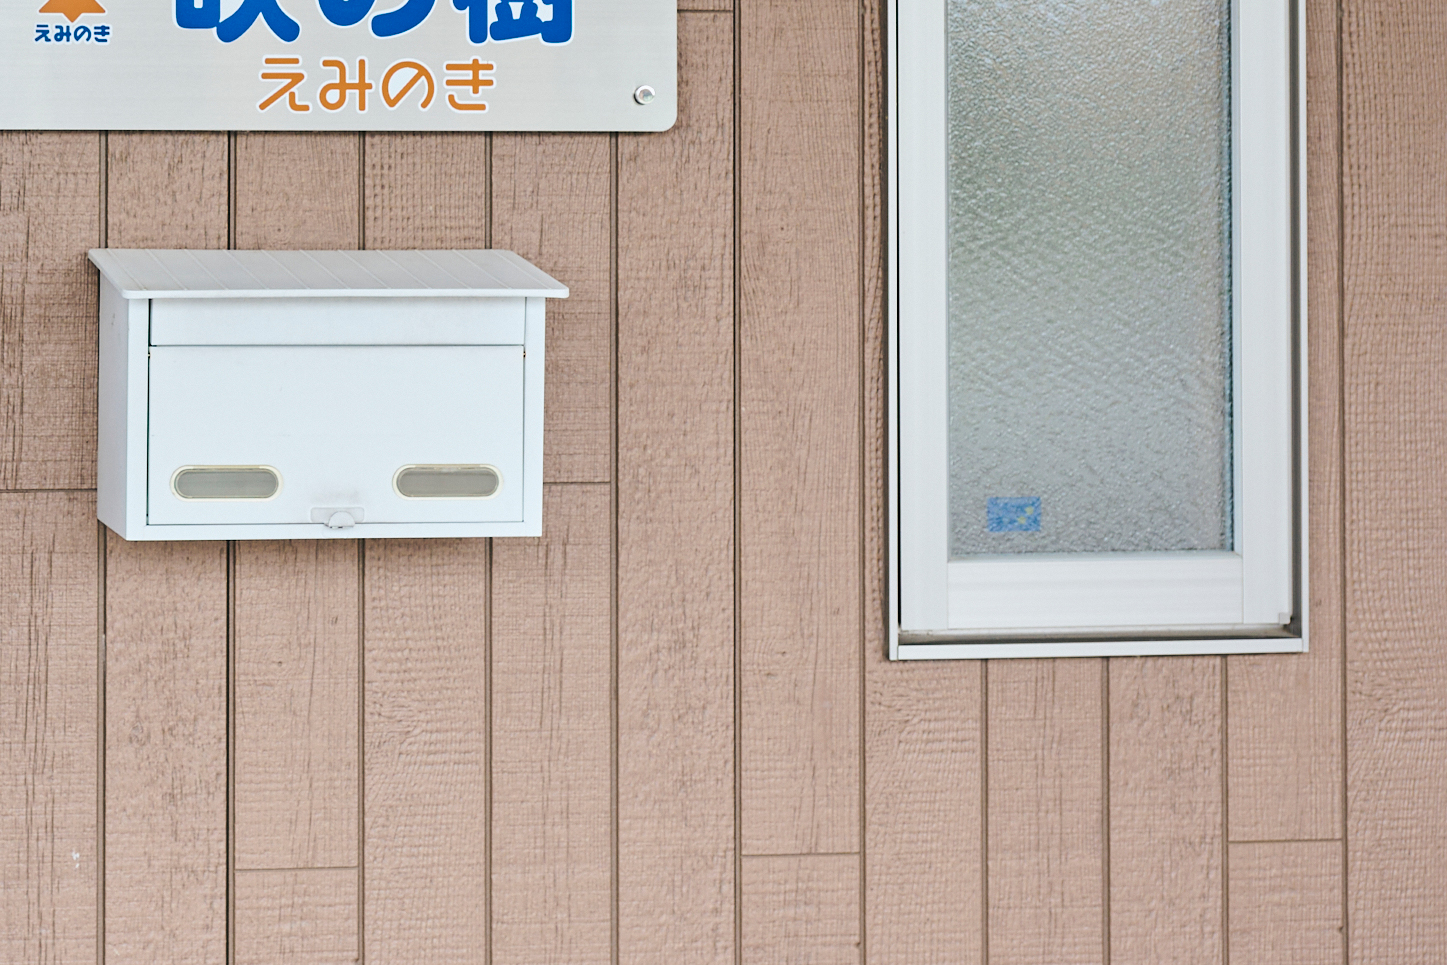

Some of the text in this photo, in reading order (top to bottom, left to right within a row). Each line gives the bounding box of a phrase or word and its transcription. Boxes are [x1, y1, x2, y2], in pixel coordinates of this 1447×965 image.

[33, 23, 112, 43] えみのき
[257, 56, 495, 113] えみのき
